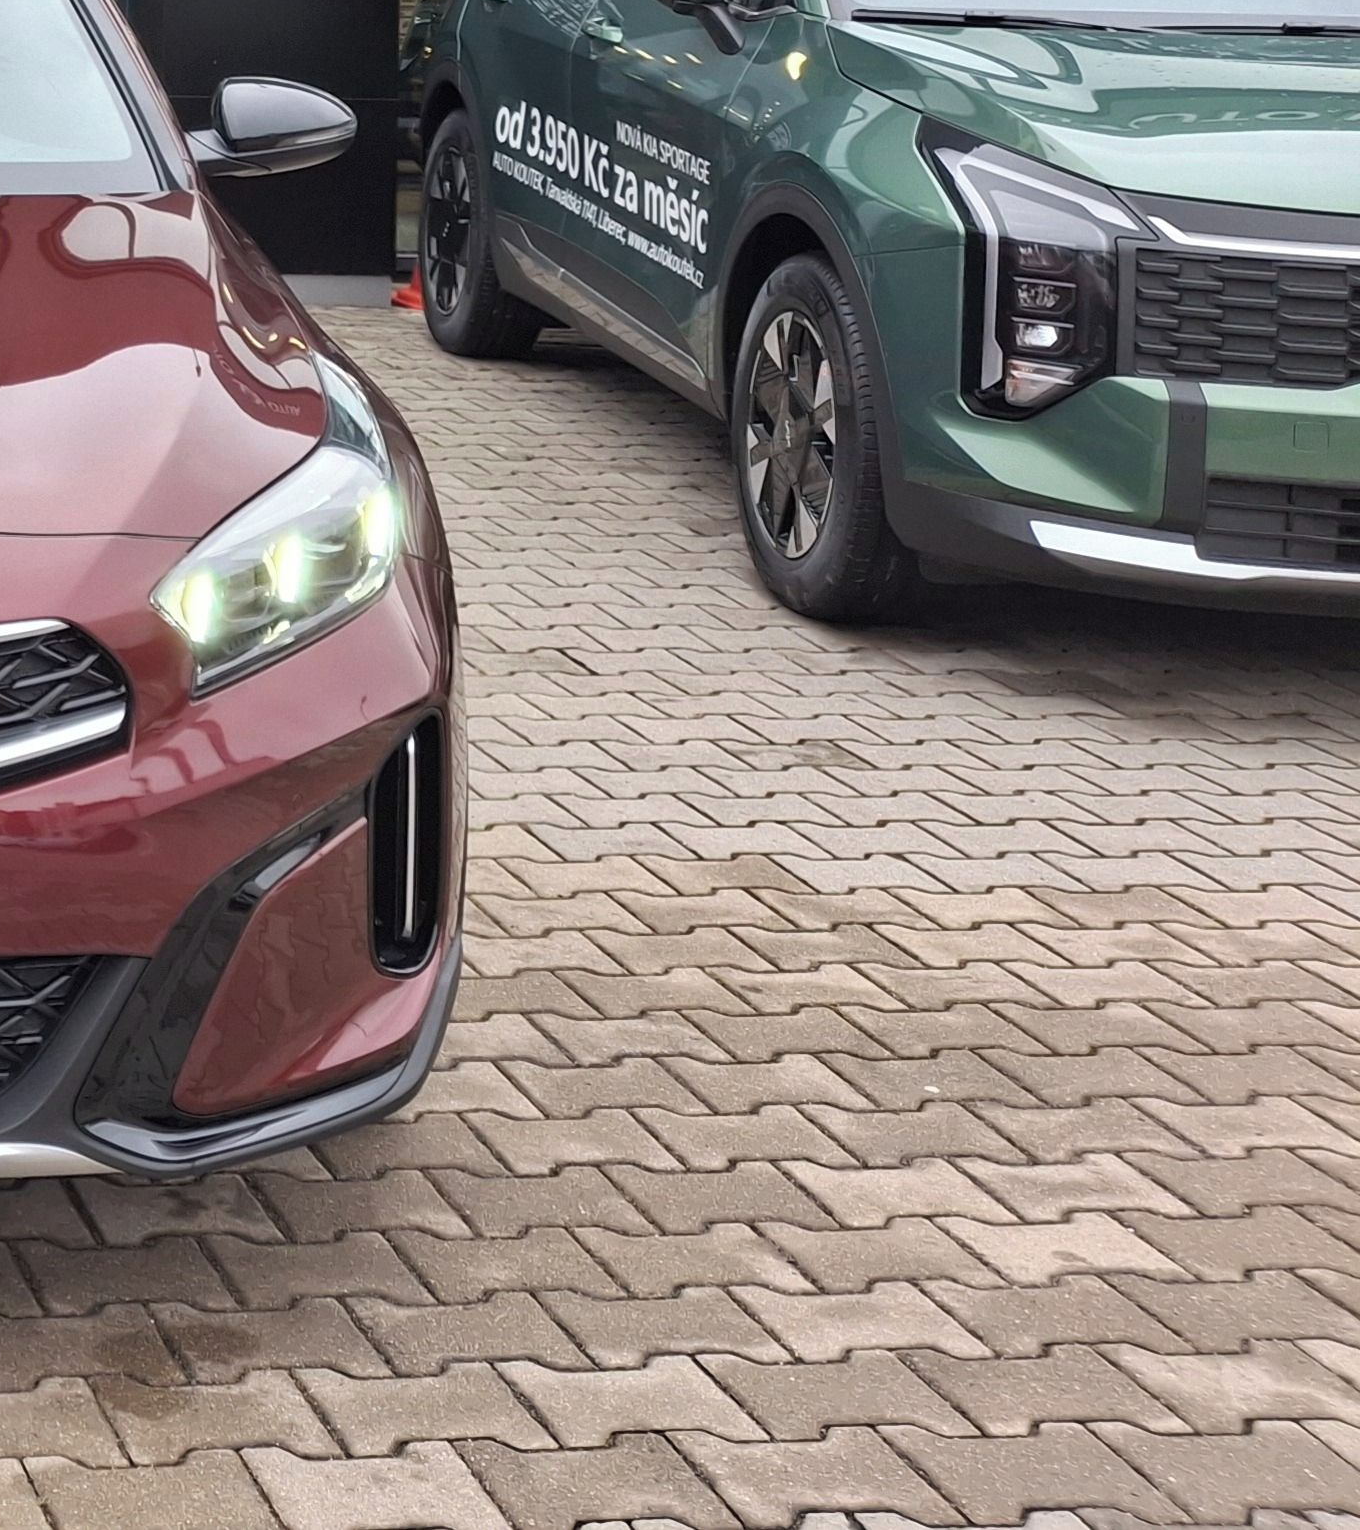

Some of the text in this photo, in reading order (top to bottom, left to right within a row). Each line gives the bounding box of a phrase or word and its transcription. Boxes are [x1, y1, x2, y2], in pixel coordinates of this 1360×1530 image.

[492, 150, 515, 176] AUTO
[513, 158, 544, 196] KOUTEK,
[545, 175, 583, 216] Tanvaldská
[597, 210, 627, 246] Liberec,
[627, 229, 705, 290] www.autokoutek.cz
[495, 100, 709, 255] od 3.950 Kč za měsíc
[616, 120, 711, 186] NOVÁ KIA SPORTAGE
